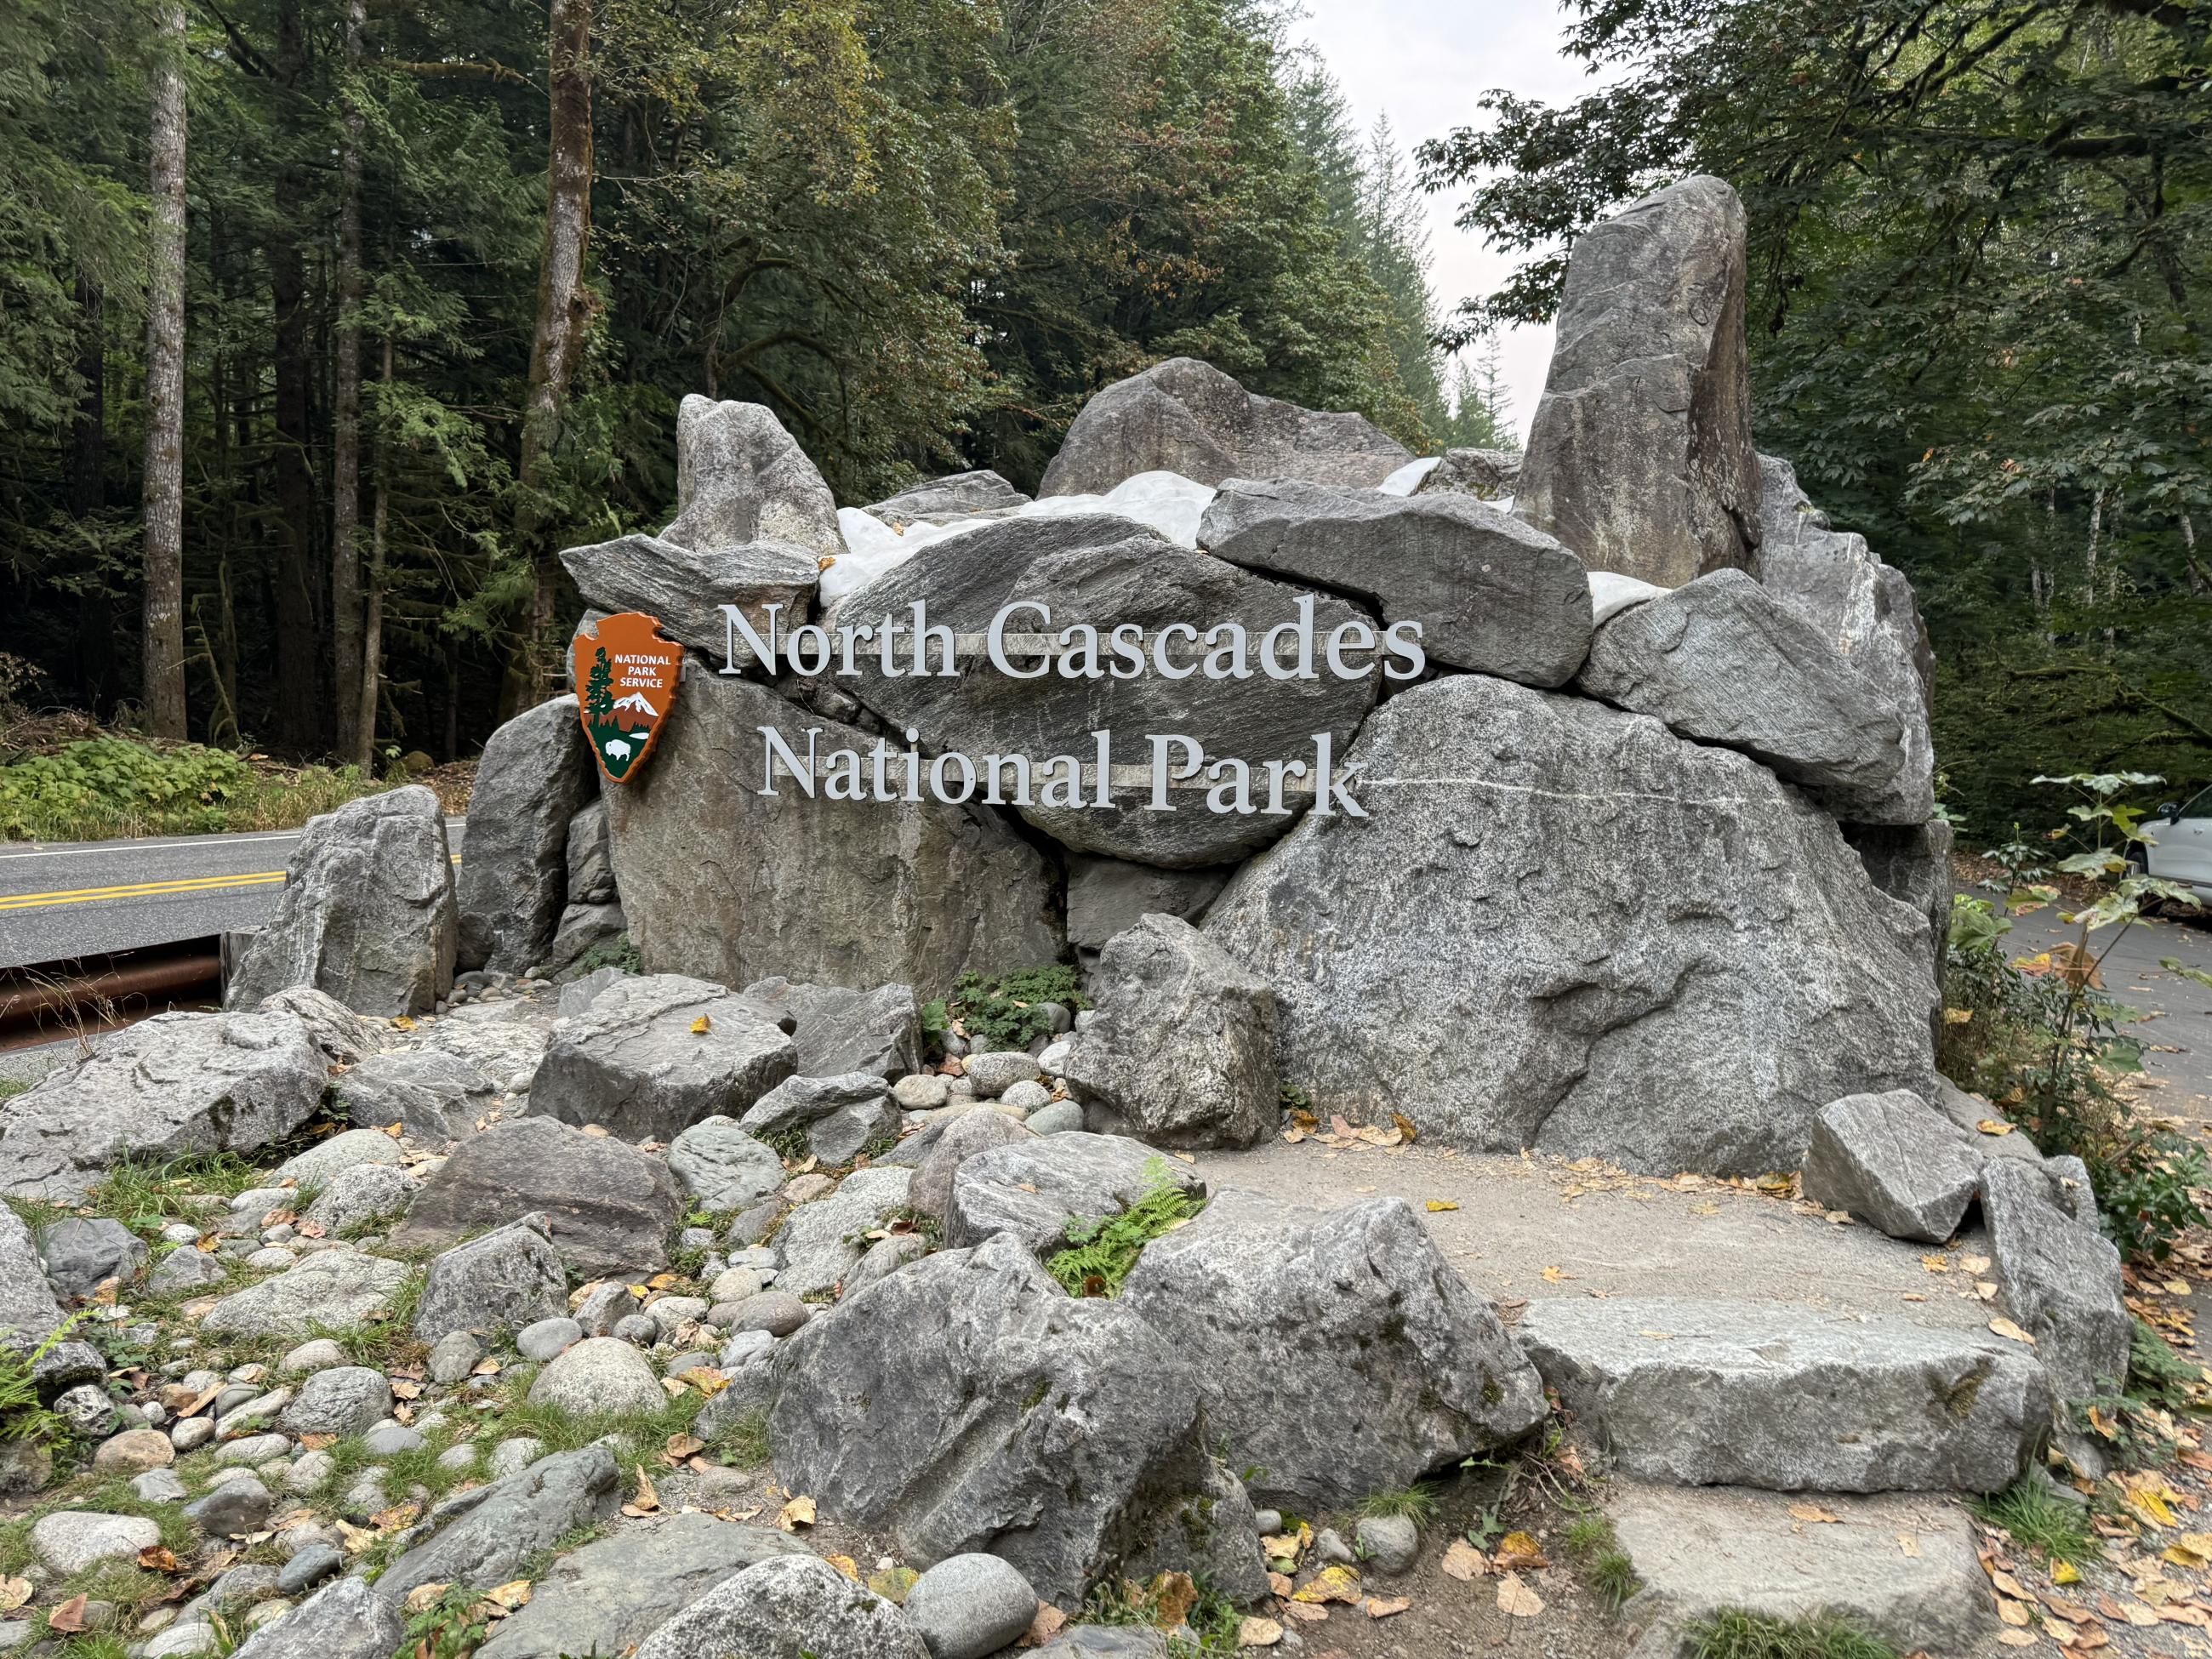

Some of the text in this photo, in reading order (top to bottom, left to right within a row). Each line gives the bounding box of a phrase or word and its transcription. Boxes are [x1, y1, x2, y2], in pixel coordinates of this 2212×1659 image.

[717, 593, 1427, 681] North Cascades
[615, 655, 670, 665] NATIONAL
[628, 667, 656, 676] PARK
[620, 678, 663, 688] SERVICE
[756, 726, 1371, 818] National Park
